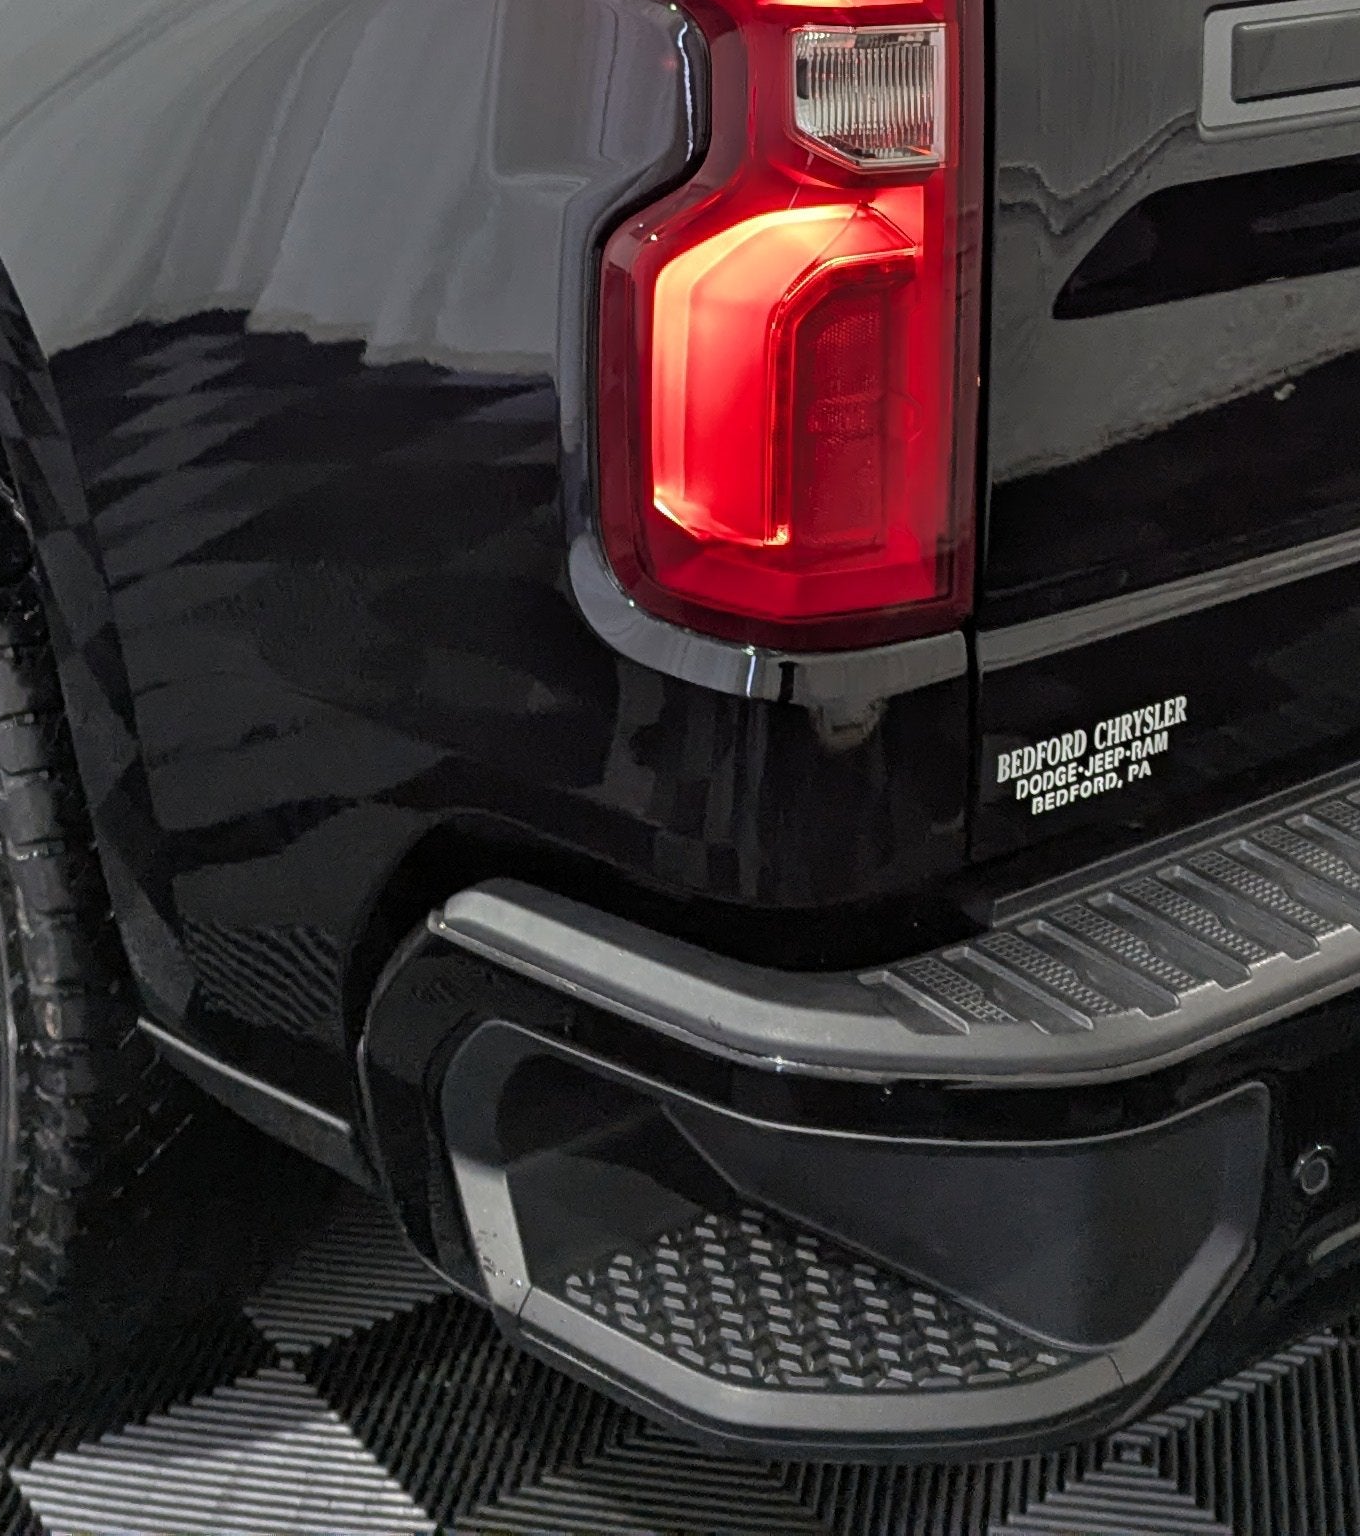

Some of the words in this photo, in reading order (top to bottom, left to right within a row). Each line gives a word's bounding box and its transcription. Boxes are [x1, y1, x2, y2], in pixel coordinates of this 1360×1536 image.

[997, 729, 1087, 783] BEDFORD
[1093, 695, 1188, 750] CHRYSLER
[1031, 772, 1123, 815] BEDFORD,
[1127, 760, 1152, 782] PA
